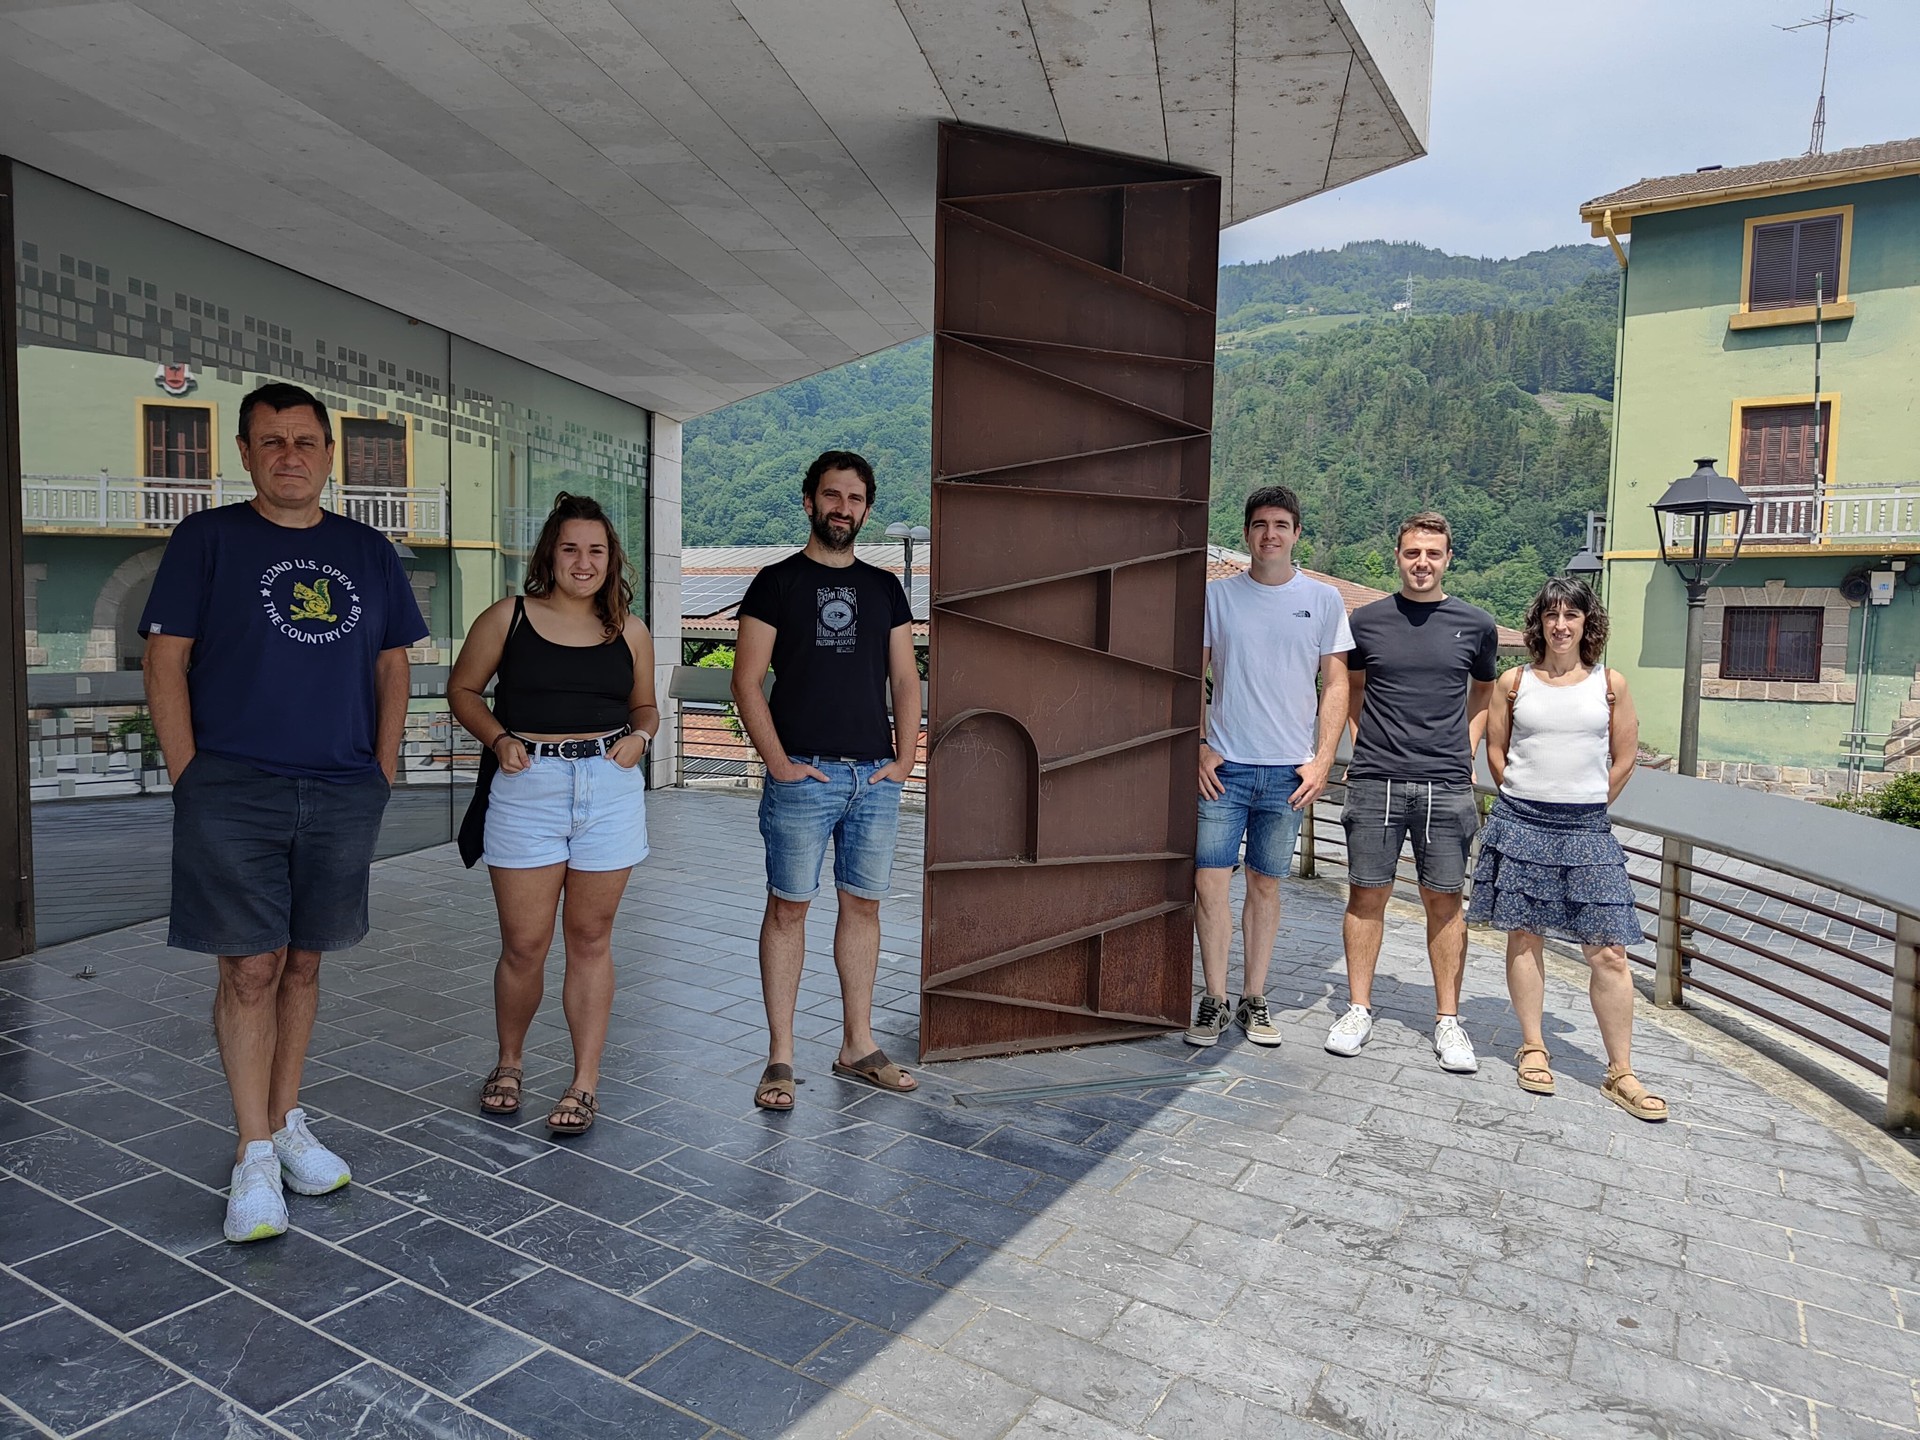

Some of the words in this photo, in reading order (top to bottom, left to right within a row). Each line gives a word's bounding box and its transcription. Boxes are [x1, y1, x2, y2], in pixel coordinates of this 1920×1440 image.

[260, 560, 293, 587] 122ND
[294, 558, 319, 571] U.S.
[322, 564, 356, 591] OPEN
[263, 600, 284, 627] THE
[280, 623, 342, 645] COUNTRY
[340, 605, 363, 634] CLUB
